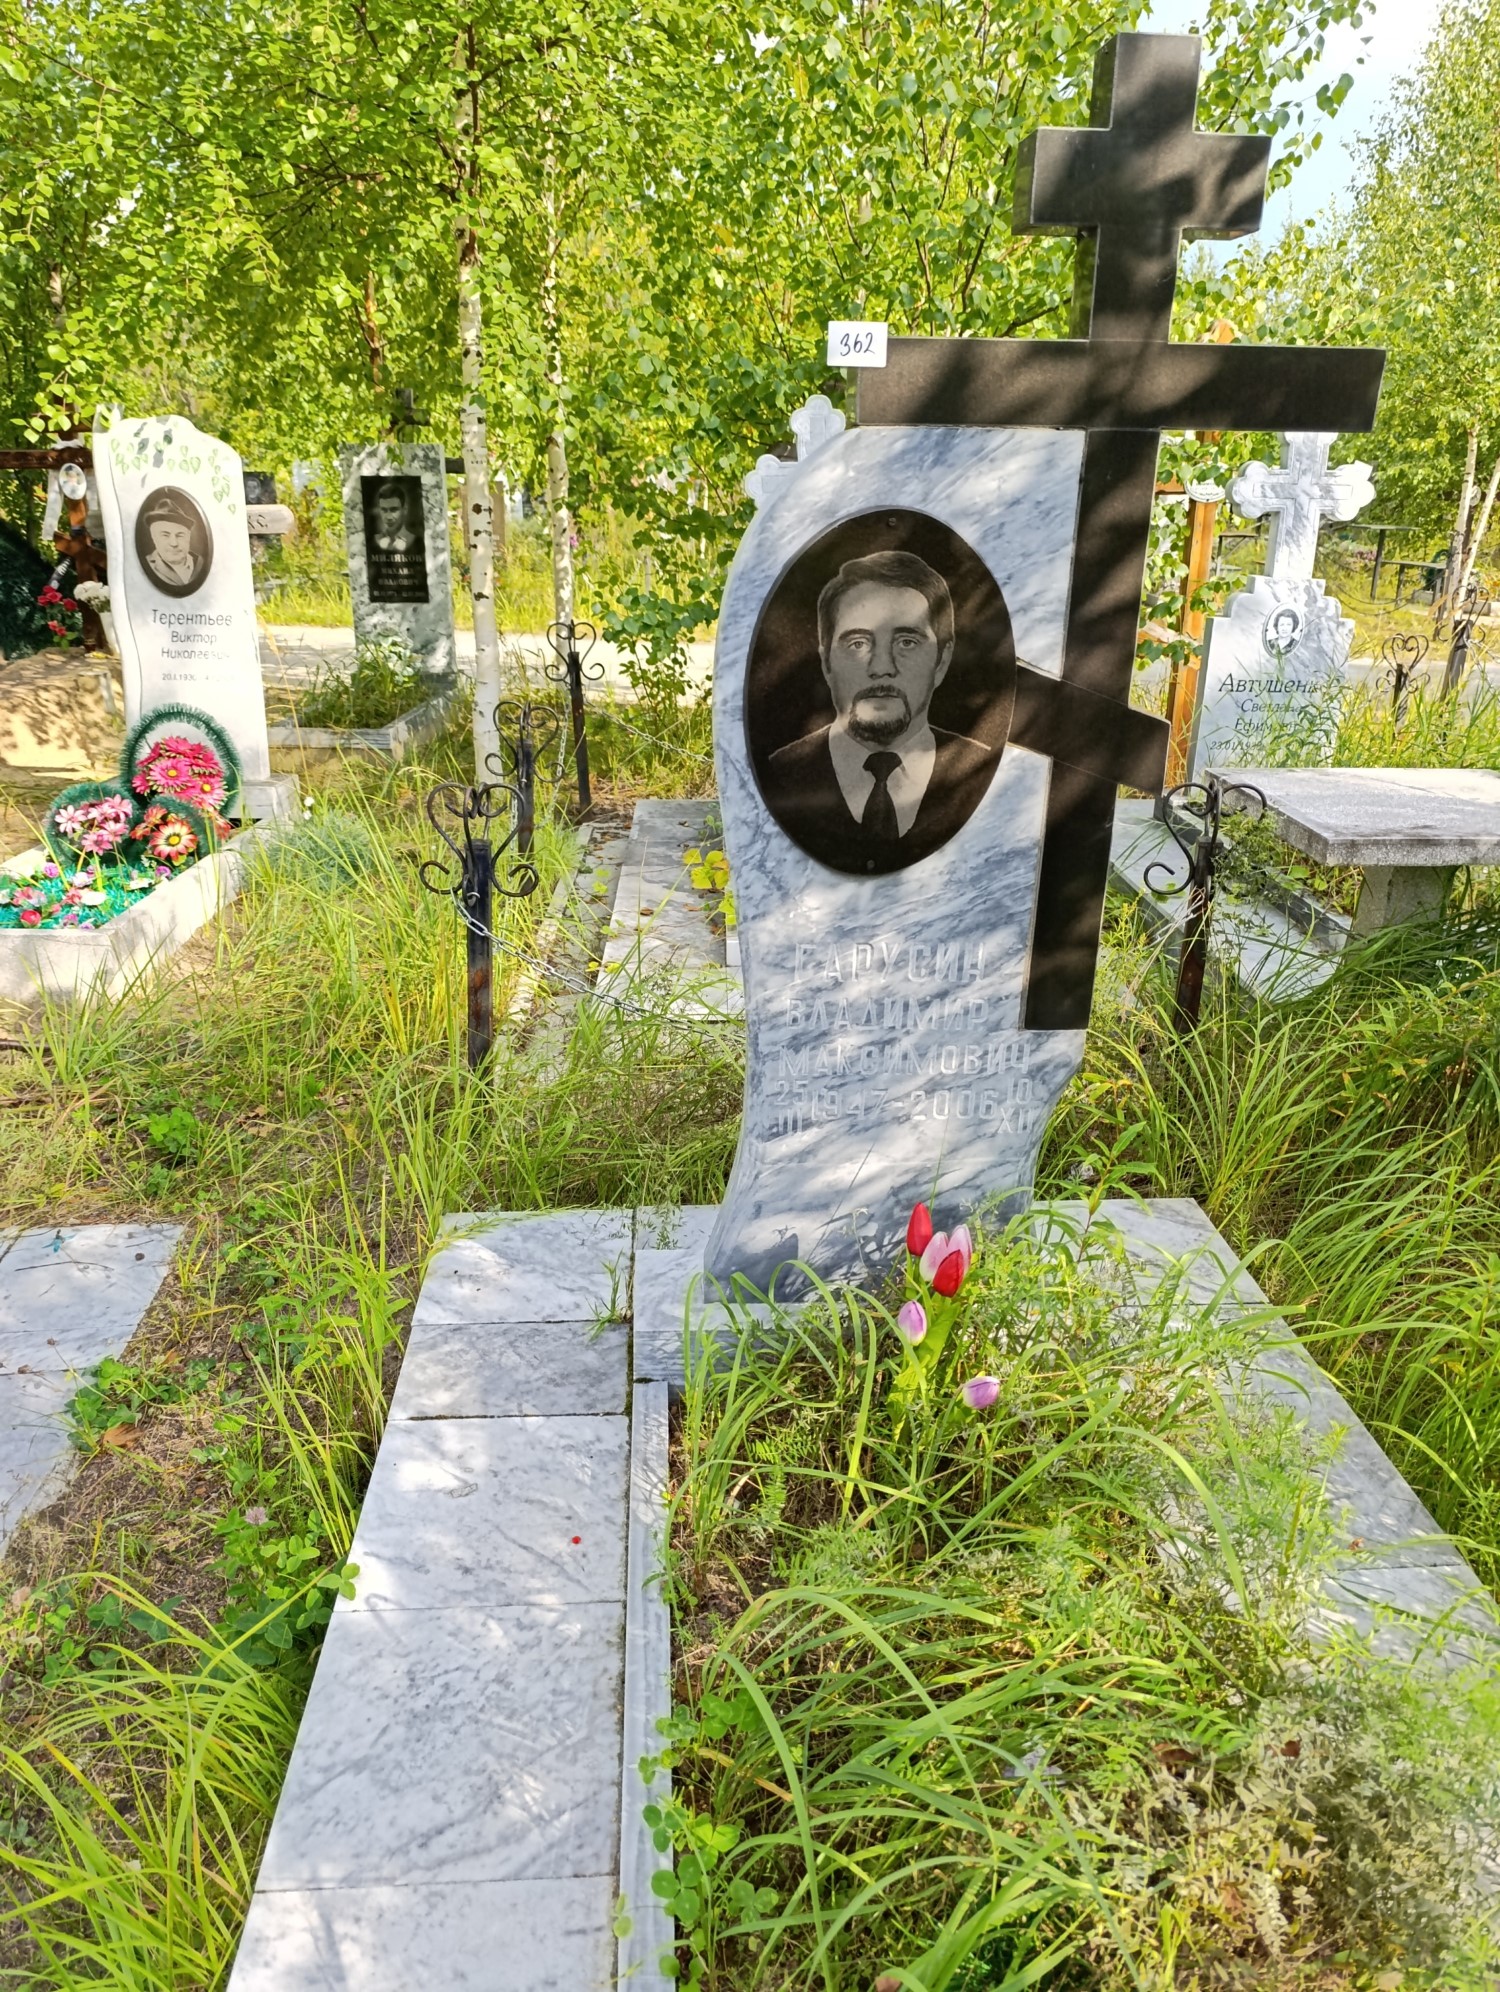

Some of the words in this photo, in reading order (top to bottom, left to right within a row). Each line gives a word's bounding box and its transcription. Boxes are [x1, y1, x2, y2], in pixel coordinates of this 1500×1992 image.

[840, 332, 875, 356] 362
[152, 609, 232, 628] Терентьев
[171, 630, 217, 645] Виктор
[1218, 673, 1322, 698] Автушенк
[794, 942, 986, 983] ГАРУСИН
[786, 998, 989, 1031] ВЛАДИМИР
[778, 1044, 1031, 1077] МАКСИМОВИЧ
[774, 1079, 808, 1107] 25
[1005, 1077, 1033, 1105] 10
